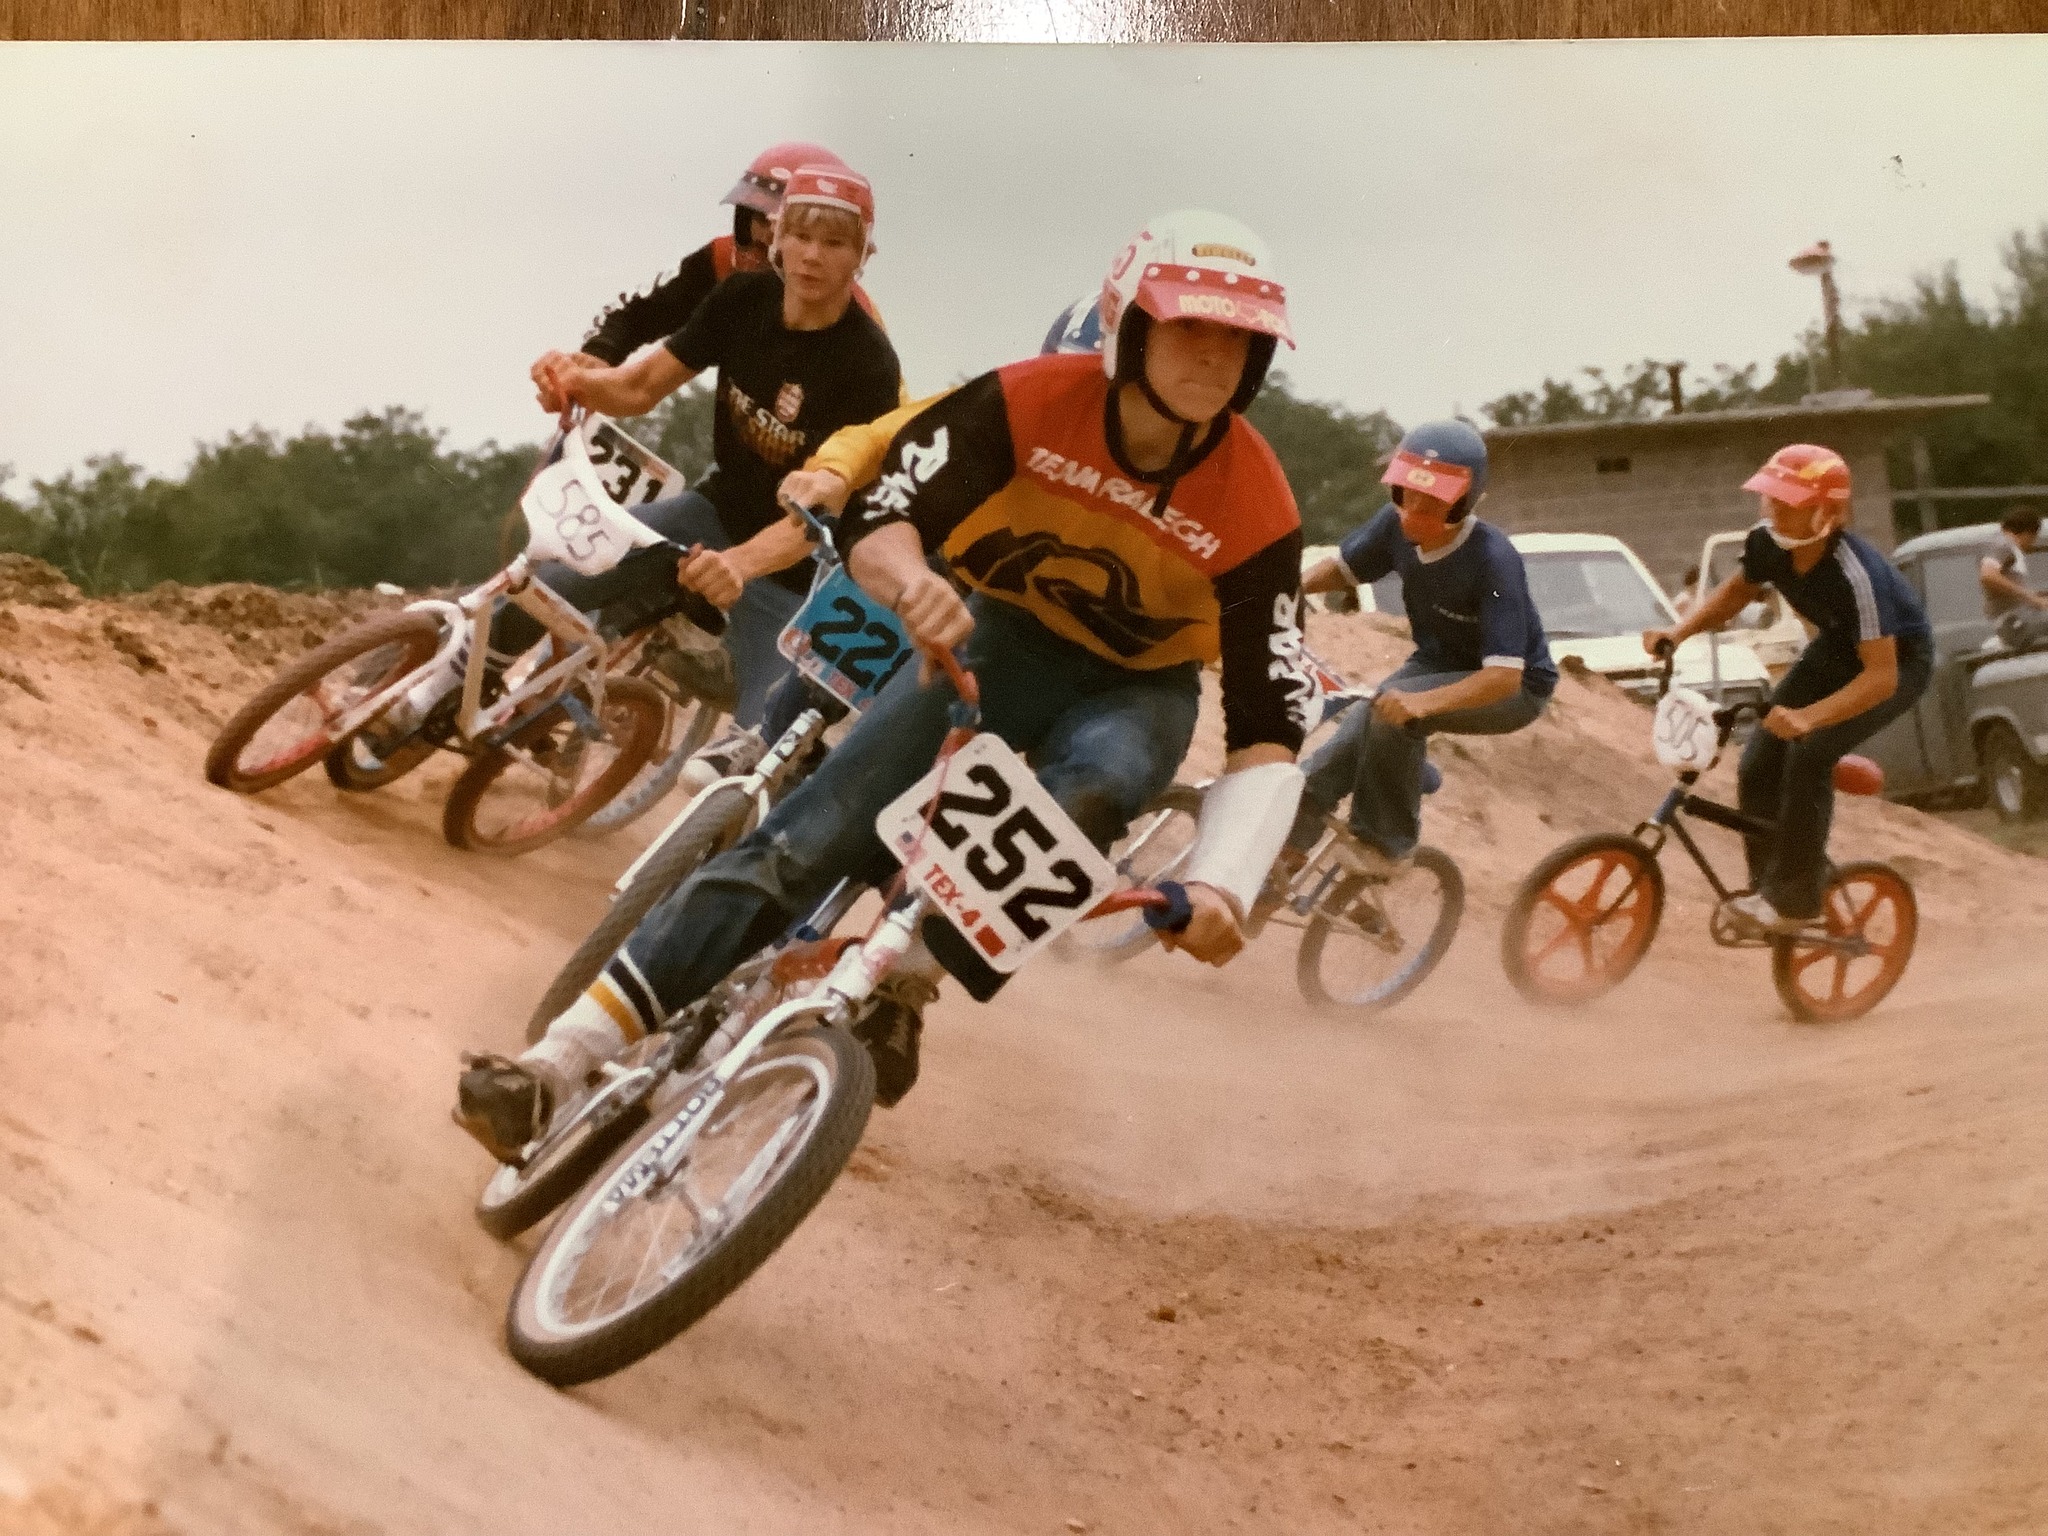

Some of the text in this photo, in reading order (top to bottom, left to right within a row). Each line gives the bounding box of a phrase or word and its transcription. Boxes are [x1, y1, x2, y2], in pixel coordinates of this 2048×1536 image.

[589, 432, 663, 505] 231
[1027, 447, 1221, 560] TEAM RALEGH
[536, 479, 616, 562] 585
[917, 764, 1094, 942] 252
[923, 863, 982, 928] TEX-4
